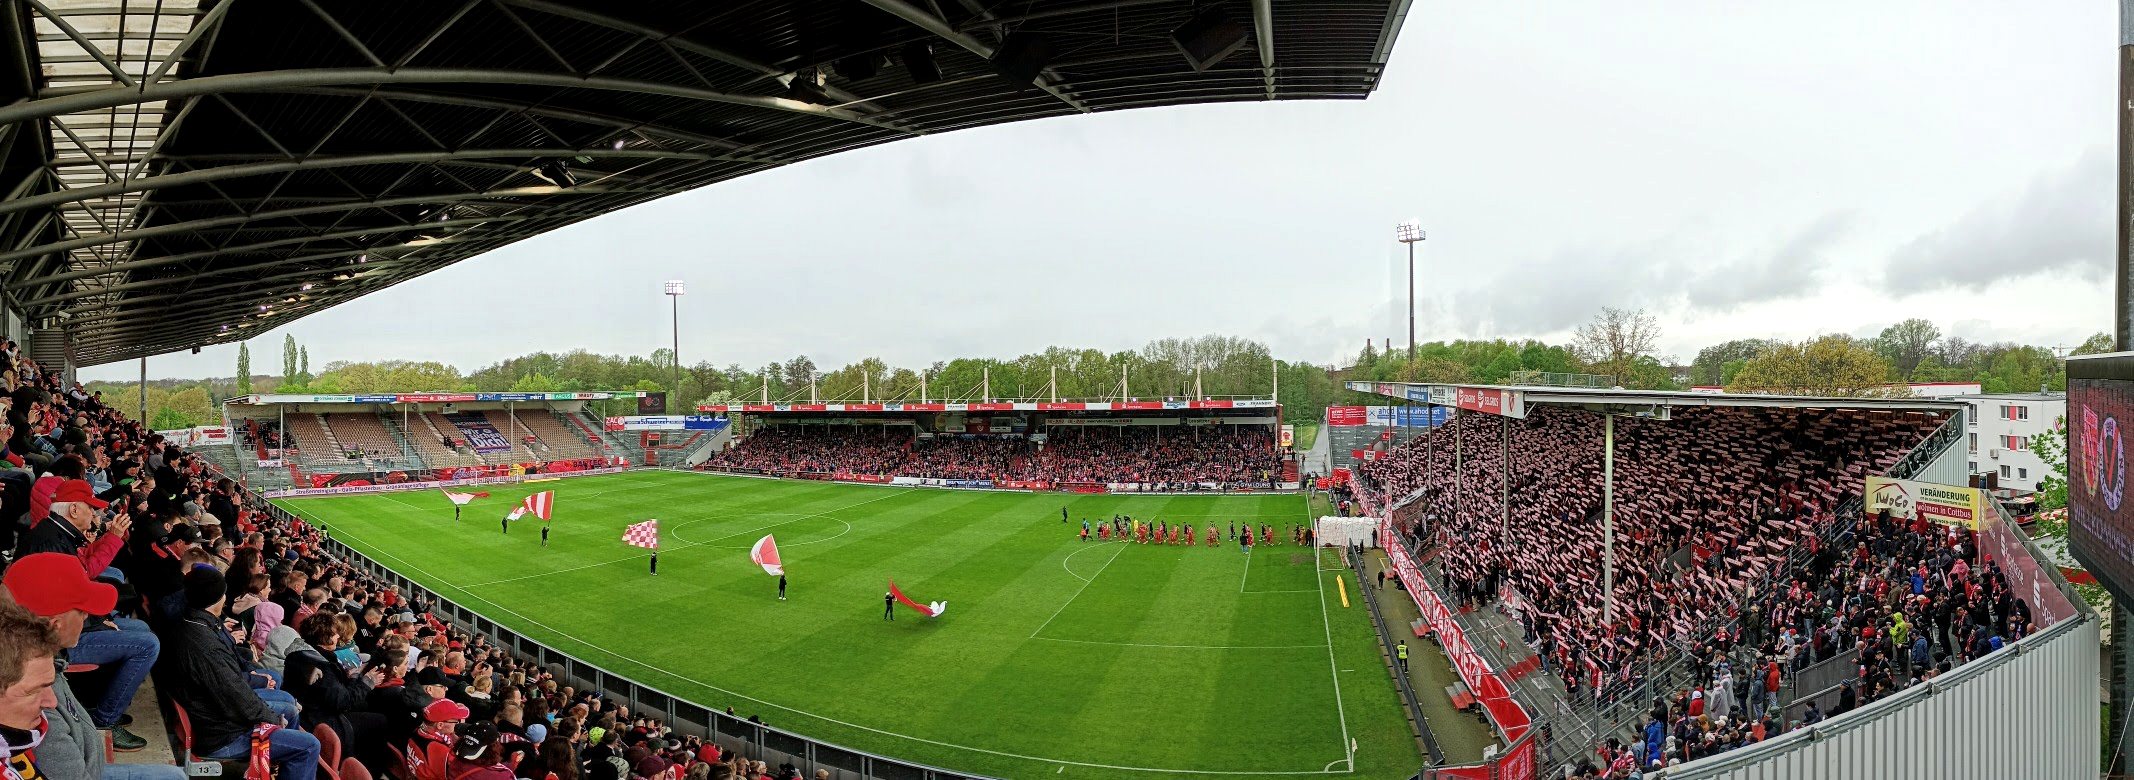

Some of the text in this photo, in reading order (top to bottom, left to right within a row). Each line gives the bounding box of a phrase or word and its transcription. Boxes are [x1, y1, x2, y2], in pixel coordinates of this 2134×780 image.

[1920, 487, 1970, 502] VERÄNDERUNG
[1940, 505, 1946, 514] in
[1947, 507, 1972, 519] Cottbus
[199, 766, 209, 774] 13
